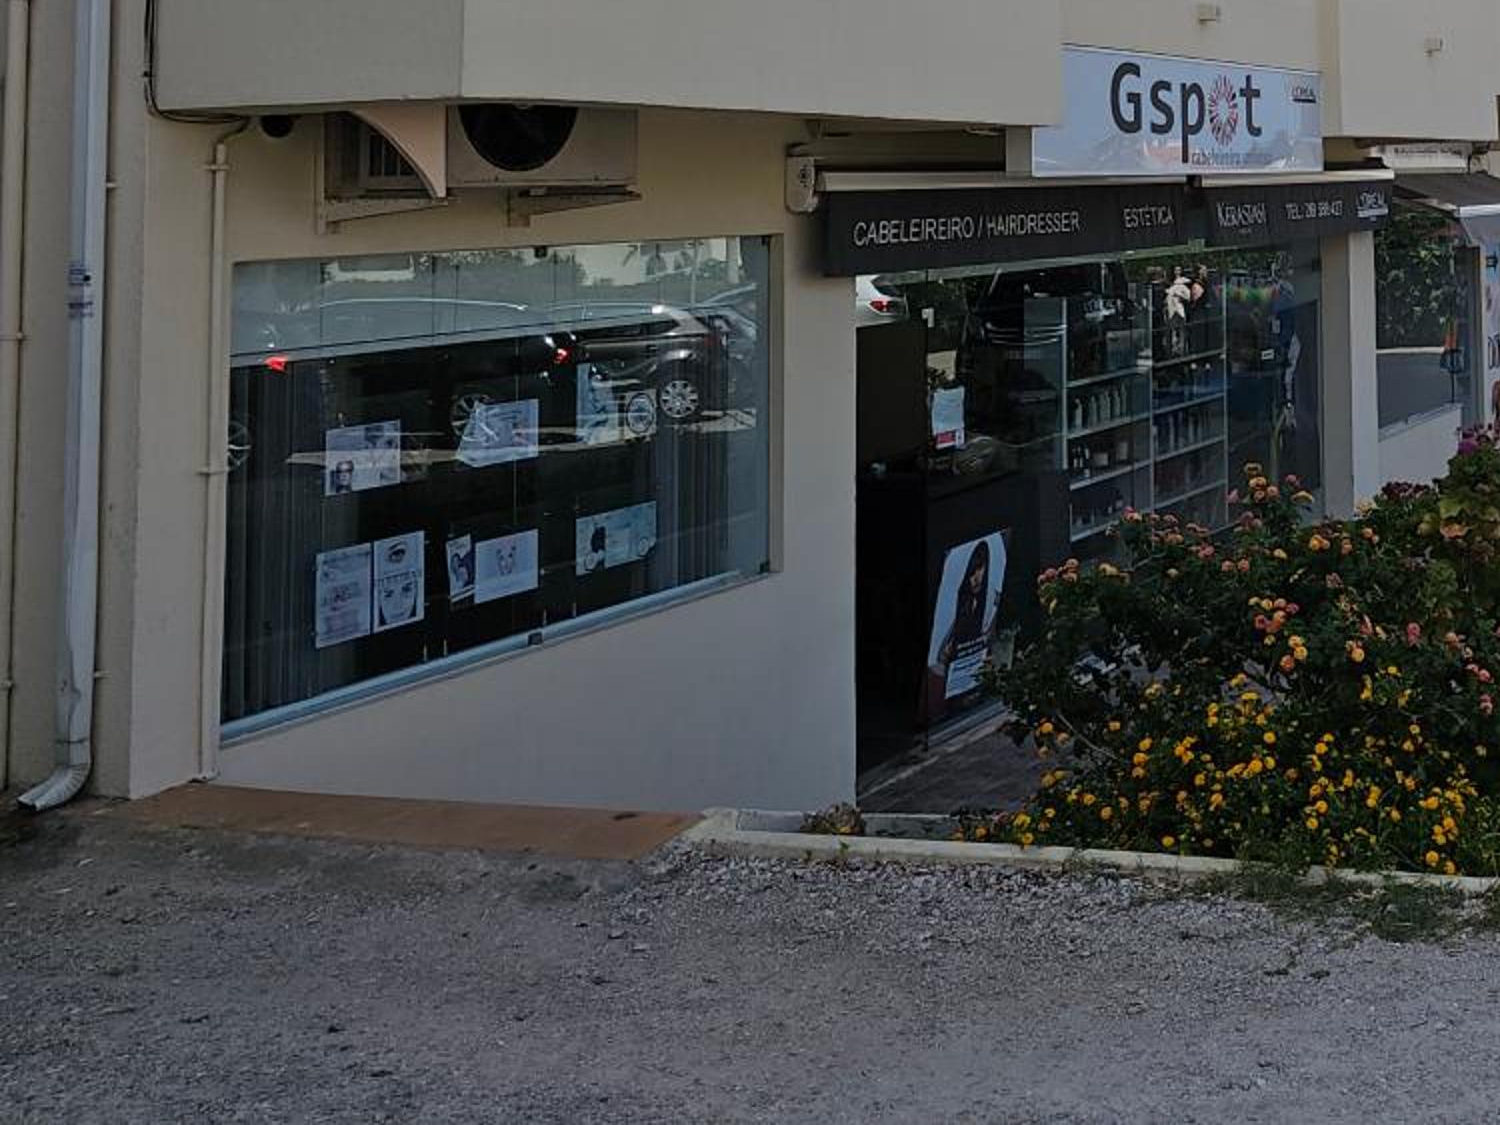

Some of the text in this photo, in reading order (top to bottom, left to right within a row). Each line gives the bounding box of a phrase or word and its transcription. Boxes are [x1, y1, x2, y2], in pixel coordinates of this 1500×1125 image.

[1110, 62, 1262, 164] Gspot
[853, 216, 975, 246] CABELEIREIRO
[987, 211, 1081, 238] HAIRDRESSER
[1123, 204, 1175, 228] ESTÉTICA
